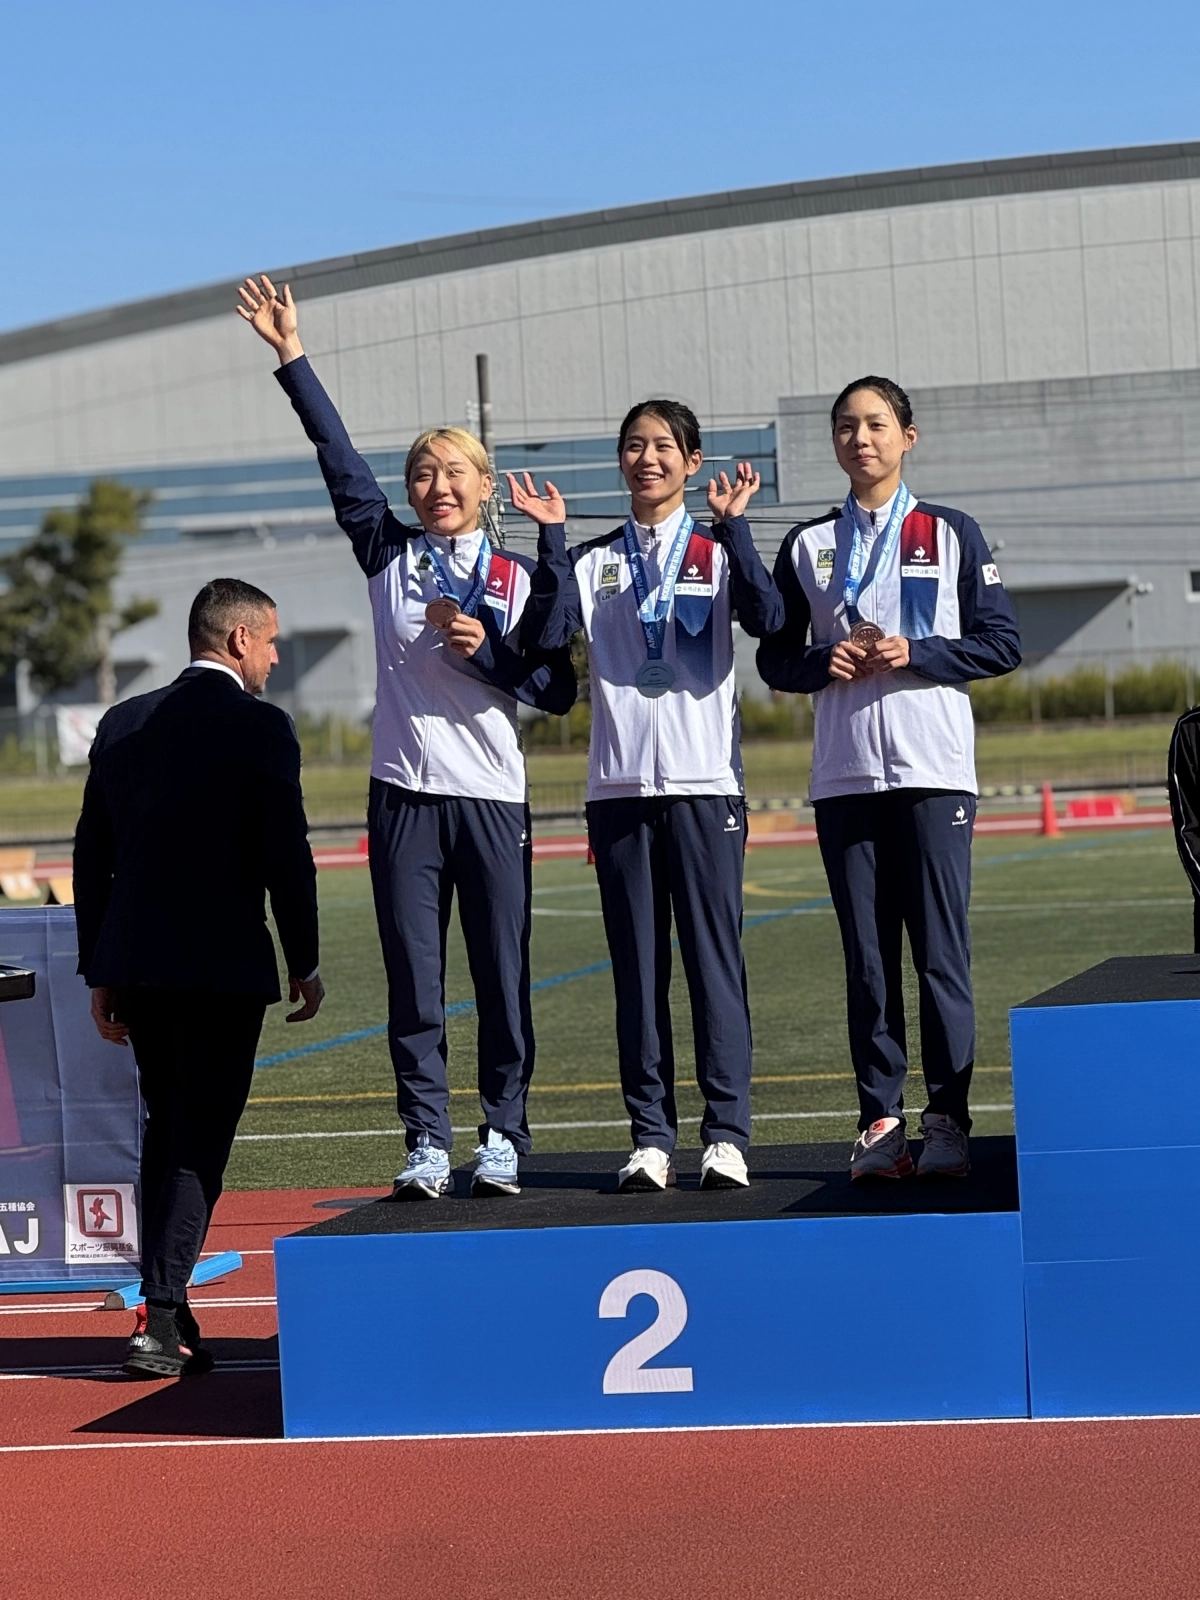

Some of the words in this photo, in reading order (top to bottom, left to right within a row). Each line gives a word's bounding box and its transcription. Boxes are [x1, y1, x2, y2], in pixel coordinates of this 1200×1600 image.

[660, 575, 673, 601] MODERN
[667, 542, 683, 576] PENTATHLON
[645, 625, 656, 648] AMPC
[0, 1202, 35, 1212] 五種協会
[598, 1268, 694, 1395] 2
